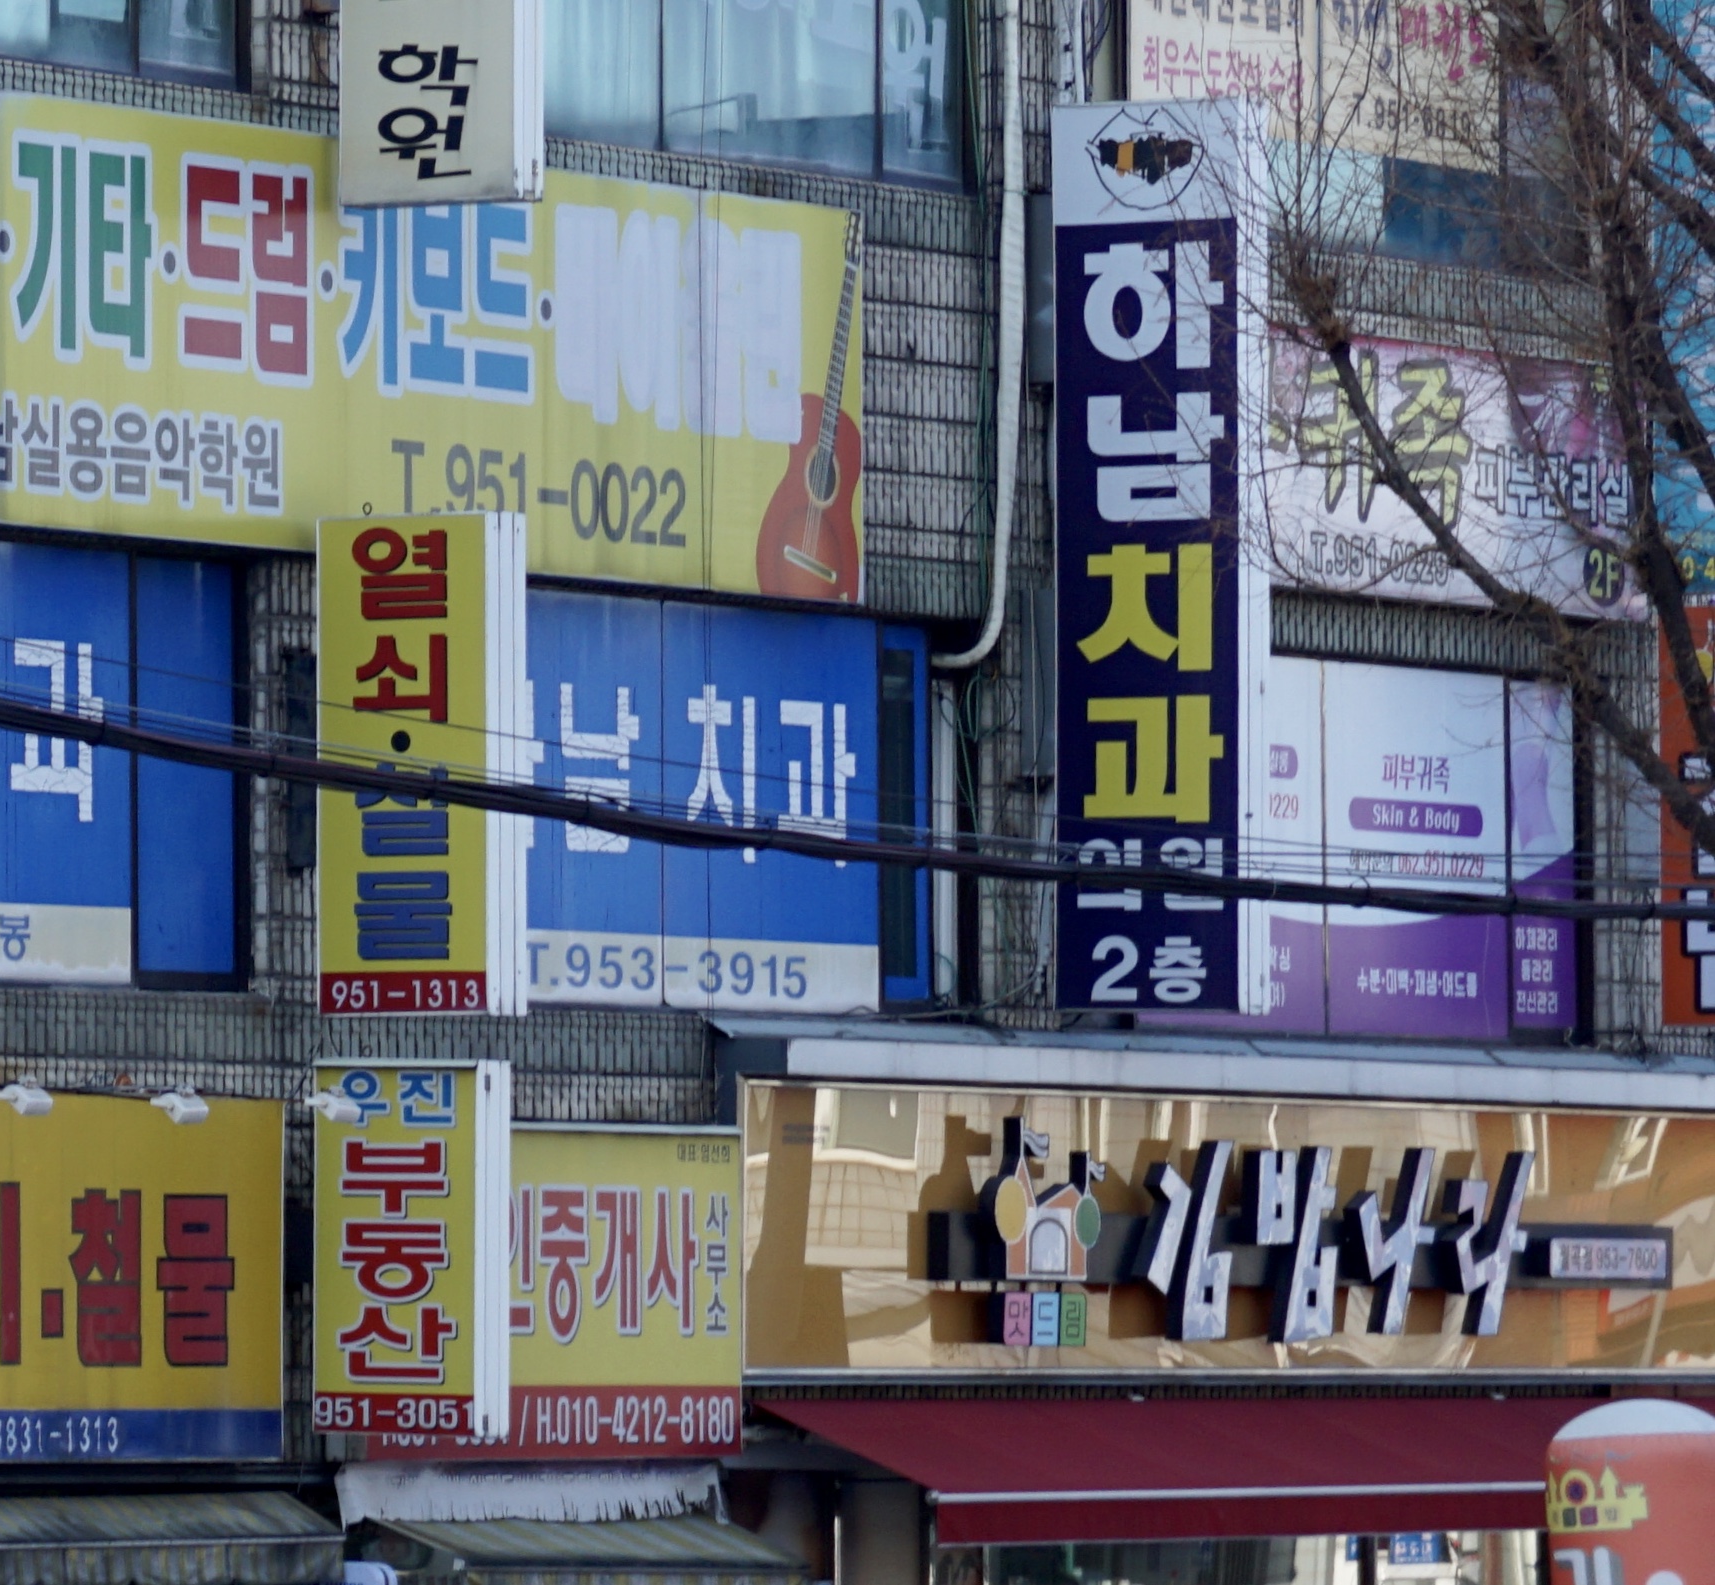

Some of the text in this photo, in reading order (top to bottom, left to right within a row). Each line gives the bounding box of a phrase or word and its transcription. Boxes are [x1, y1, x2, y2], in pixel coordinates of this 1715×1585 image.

[378, 44, 478, 181] 학원
[391, 438, 687, 548] T.951-0022
[1474, 444, 1630, 529] 피부관리실
[1588, 549, 1624, 600] 2F
[687, 684, 857, 868] 치과
[1382, 754, 1451, 795] 피부귀족
[1372, 803, 1460, 834] Skin & Body
[332, 980, 480, 1009] 951-1313
[527, 942, 808, 999] T.953-3915
[1090, 935, 1207, 1003] 2층
[340, 1069, 457, 1128] 우진
[338, 1137, 458, 1385] 부동산
[705, 1194, 729, 1334] 사무소
[315, 1396, 474, 1430] 951-3051
[536, 1396, 734, 1444] H.010-4212-8180
